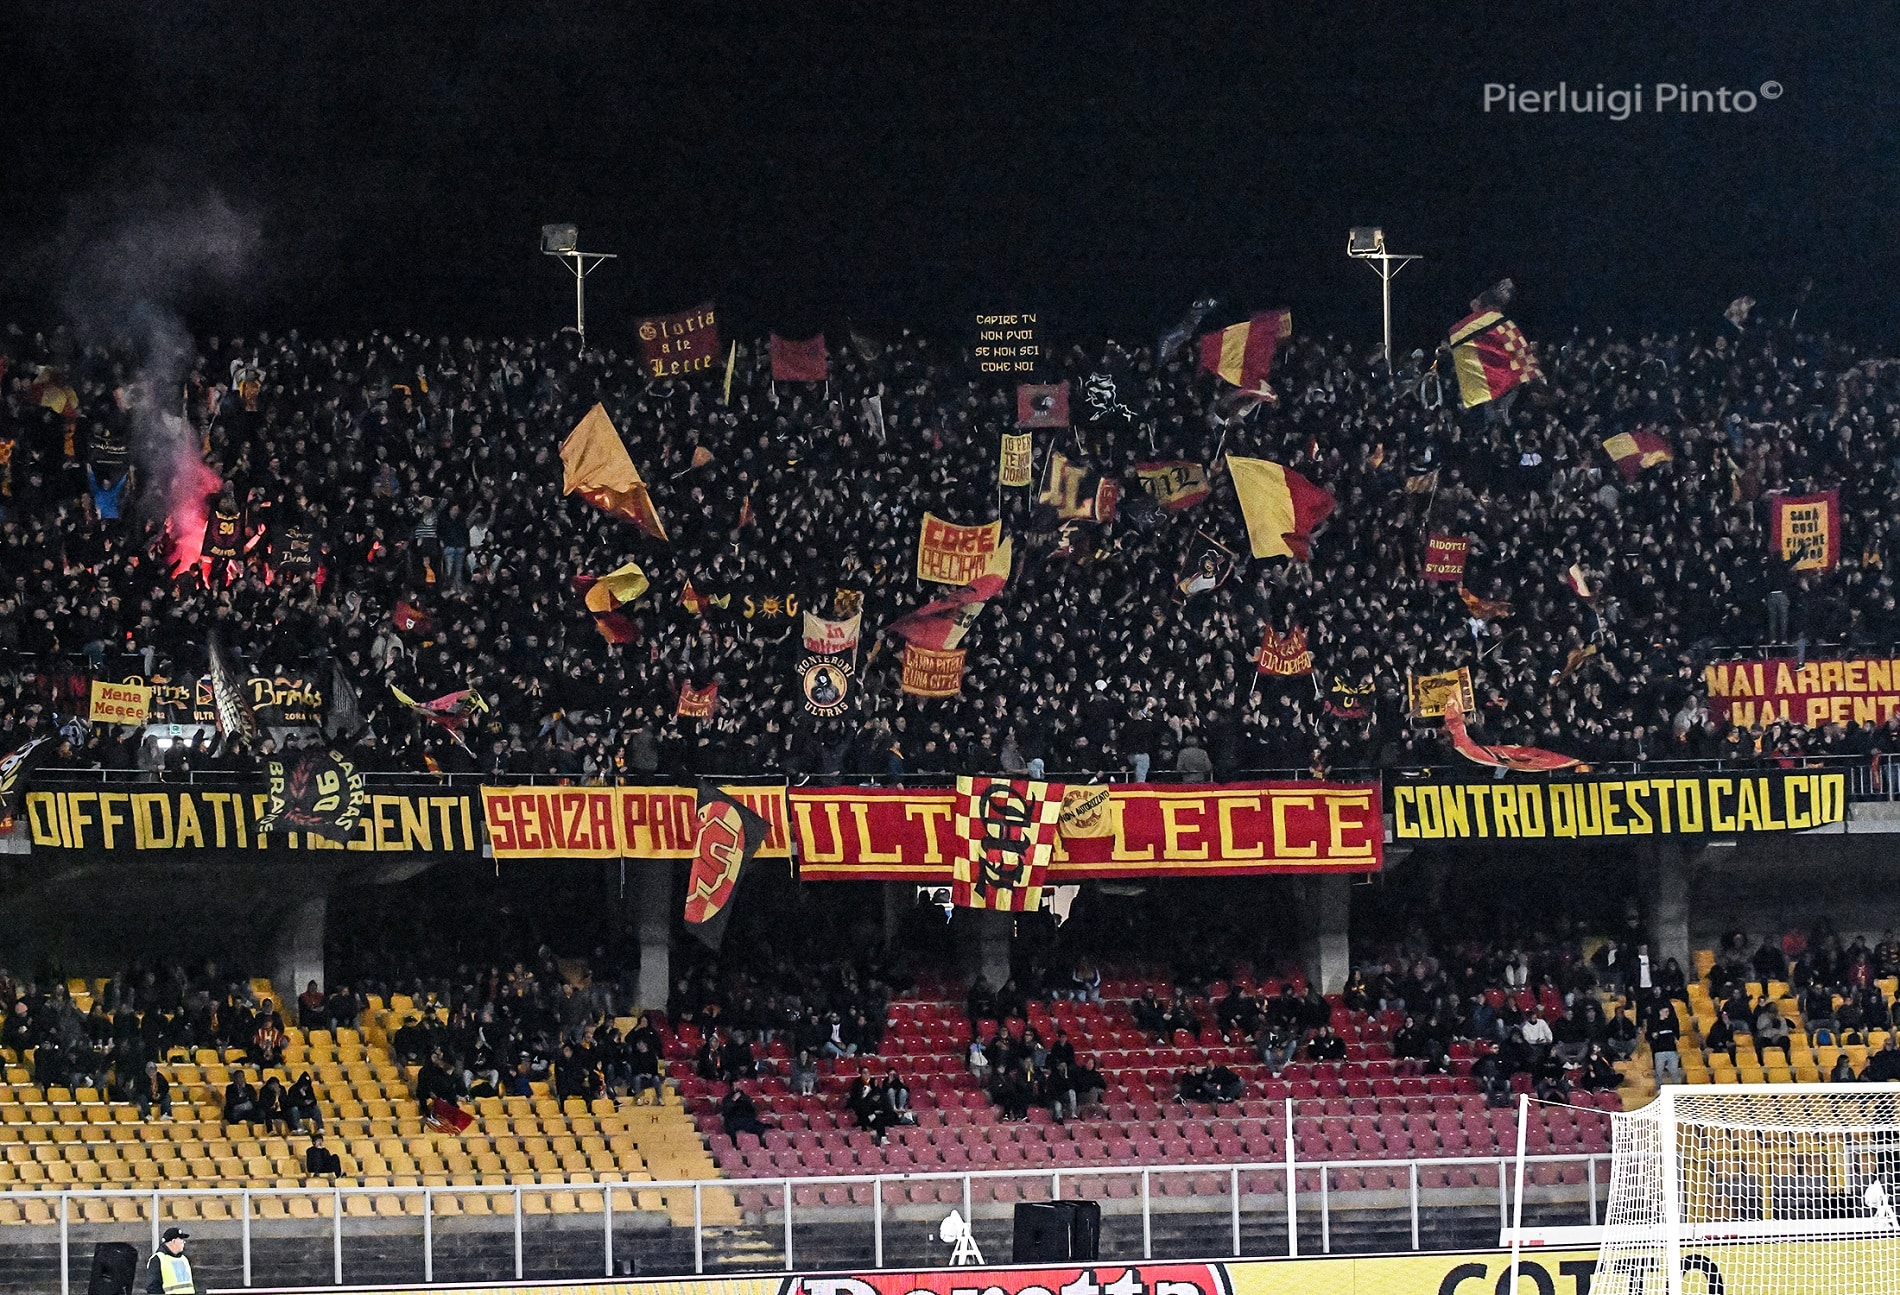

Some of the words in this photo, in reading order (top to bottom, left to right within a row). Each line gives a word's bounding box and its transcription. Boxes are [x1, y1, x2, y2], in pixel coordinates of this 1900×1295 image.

[639, 311, 714, 340] Gloria
[976, 315, 1018, 325] CAPIRE
[981, 331, 1003, 340] NON
[662, 343, 670, 353] a
[676, 340, 691, 351] te
[975, 347, 990, 356] SE
[1020, 346, 1039, 355] SEI
[650, 354, 711, 377] Lecce
[1014, 362, 1034, 371] NOI
[1443, 553, 1450, 561] A
[1425, 563, 1463, 574] STOZZE
[797, 655, 855, 678] MONTERONI
[1775, 660, 1900, 695] ARREN
[101, 688, 142, 703] Mena
[193, 711, 214, 720] ULTR
[804, 701, 849, 717] ULTRAS
[1394, 784, 1546, 838] CONTRO
[1548, 778, 1703, 839] QUESTO
[1708, 773, 1844, 833] CALCIO
[25, 791, 247, 849] DIFFIDATI
[487, 794, 617, 851] SENZA
[622, 793, 786, 850] PADNI
[1110, 795, 1373, 861] LECCE
